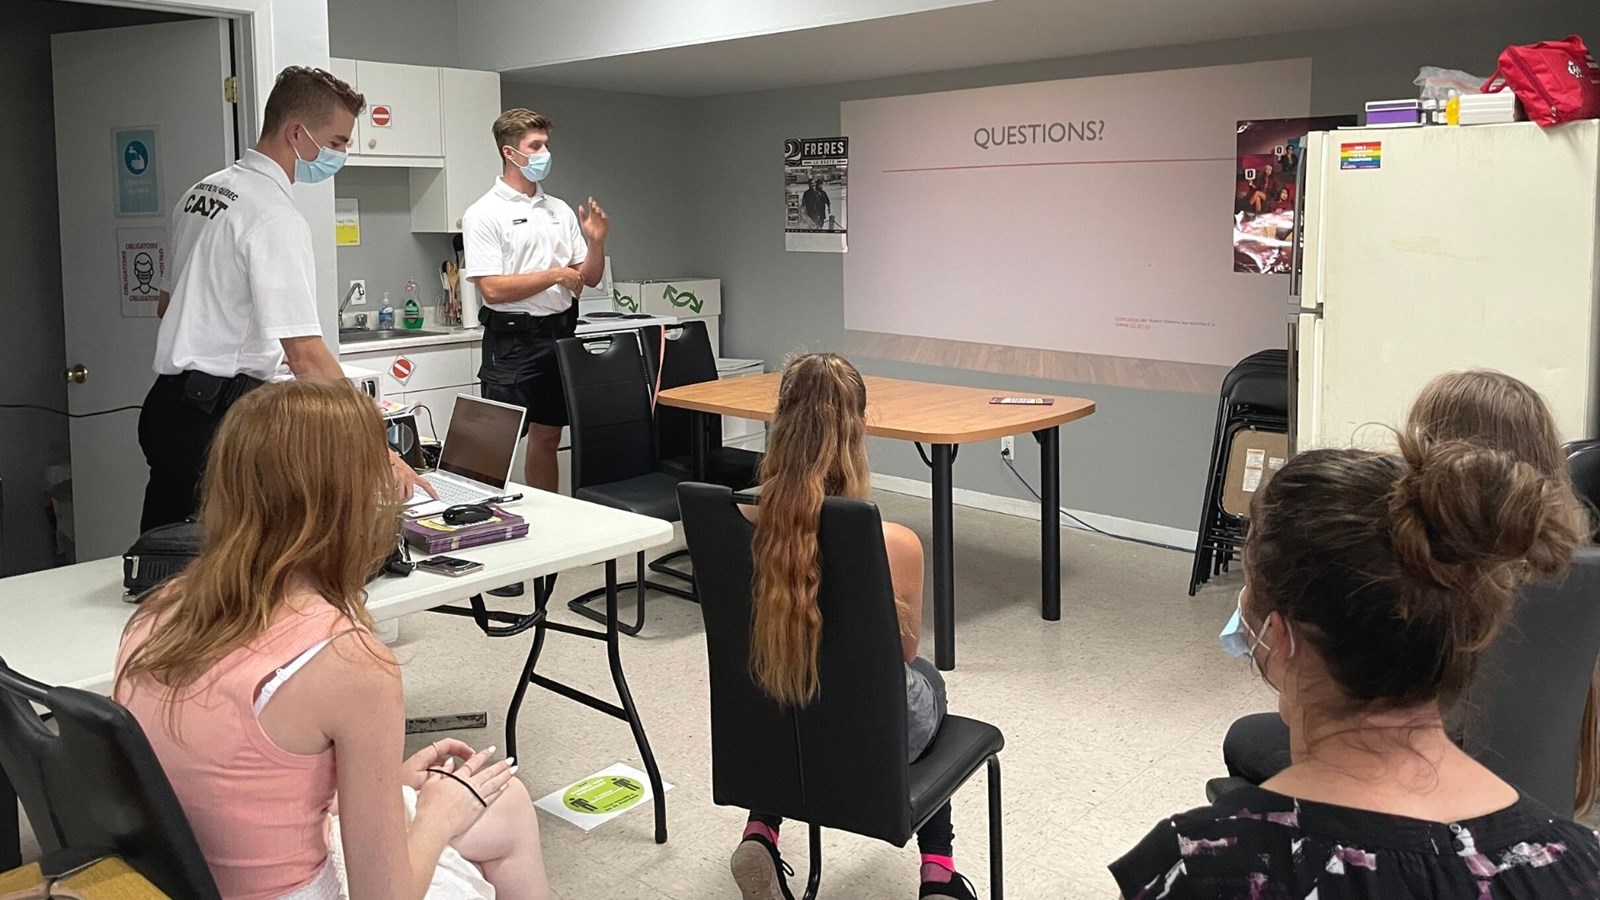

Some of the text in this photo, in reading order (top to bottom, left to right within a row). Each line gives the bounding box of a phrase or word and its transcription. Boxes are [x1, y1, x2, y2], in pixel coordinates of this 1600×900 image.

[973, 119, 1106, 150] QUESTIONS?
[125, 242, 158, 250] OBLIGATOIRE
[121, 250, 129, 296] OBLIGATOIRE
